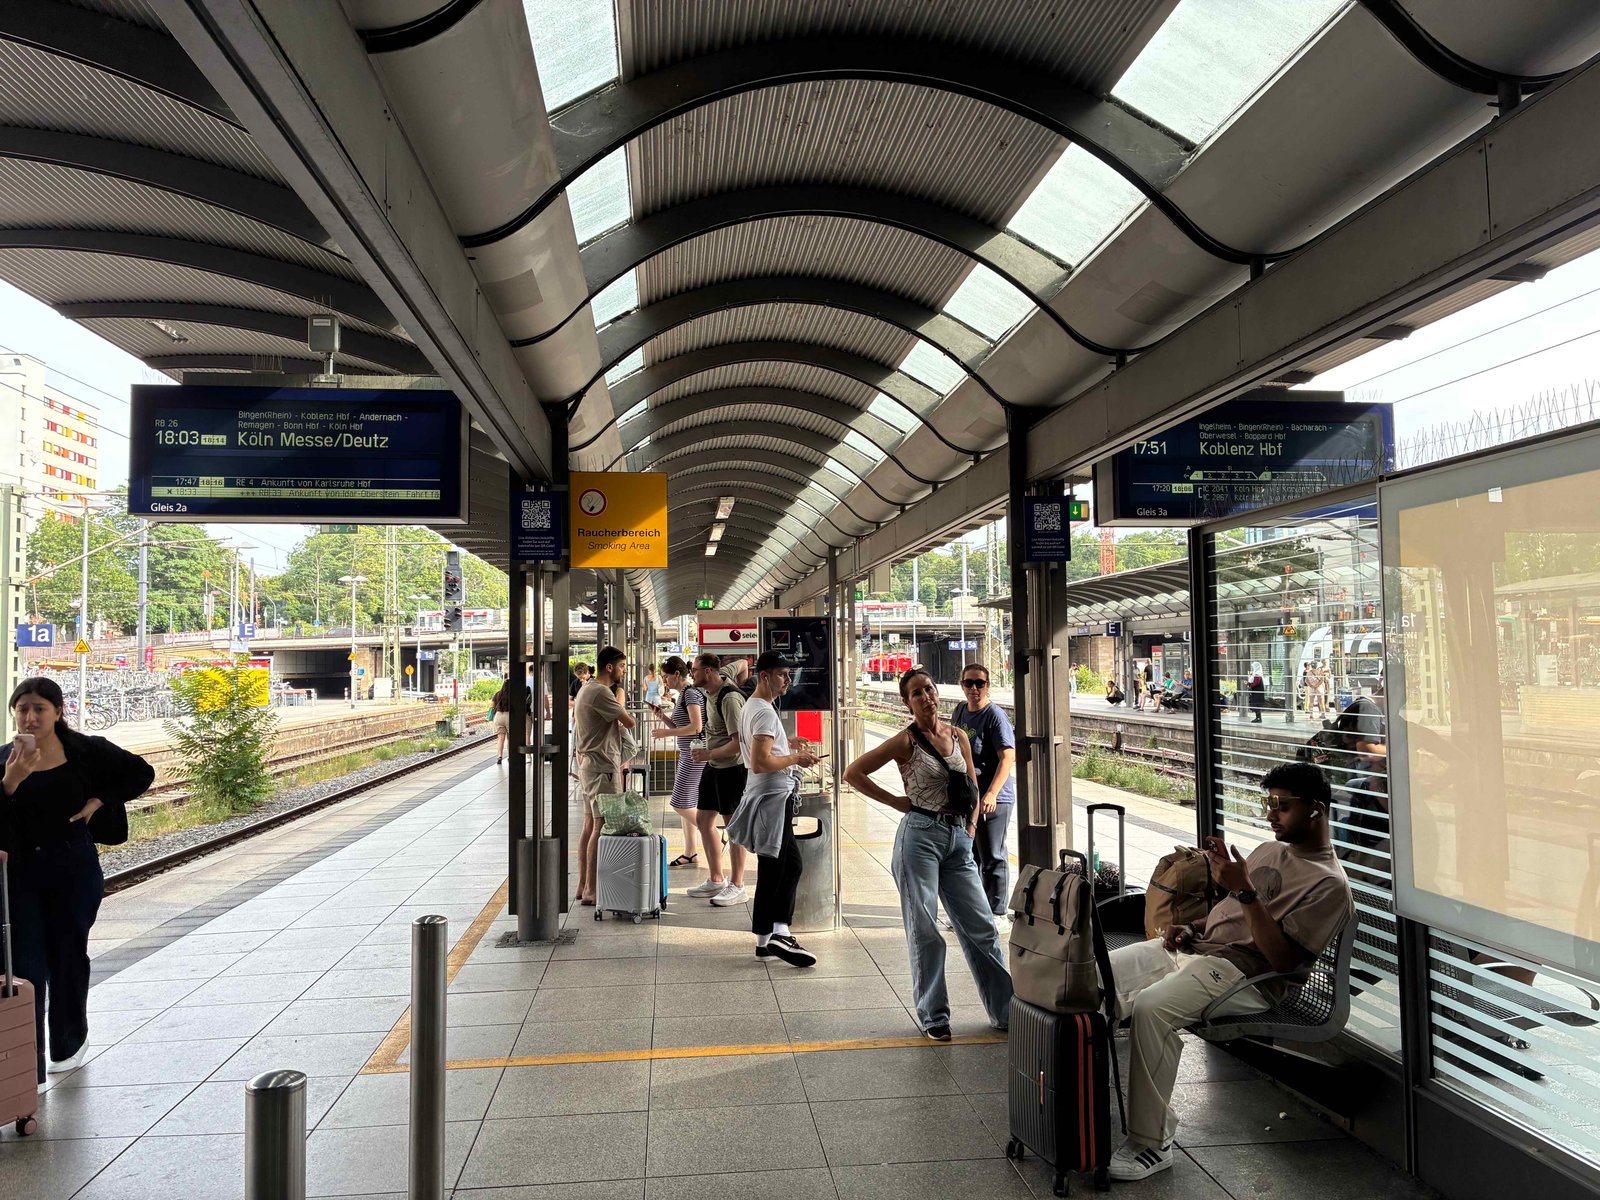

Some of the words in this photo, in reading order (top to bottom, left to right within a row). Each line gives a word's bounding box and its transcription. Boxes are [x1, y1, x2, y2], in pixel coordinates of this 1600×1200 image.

[238, 411, 292, 421] Bingen(Rhein)
[300, 412, 334, 420] Koblenz
[336, 412, 350, 420] Hbf
[359, 413, 402, 421] Andernach
[155, 419, 166, 427] RB
[168, 420, 178, 428] 26
[238, 421, 274, 430] Remagen
[1199, 424, 1232, 432] Ingelheim
[1238, 424, 1284, 432] Bingen(Rhein)
[155, 430, 200, 445] 18:03
[238, 432, 274, 446] Köln
[280, 432, 388, 448] Messe/Deutz
[1134, 441, 1167, 454] 17:51
[1200, 442, 1254, 456] Koblenz
[1260, 442, 1282, 456] Hbf
[261, 479, 294, 487] Ankunft
[150, 502, 174, 512] Gleis
[176, 502, 187, 512] 2a
[1136, 508, 1156, 516] Gleis
[1158, 508, 1168, 516] 3a
[578, 528, 660, 537] Raucherbereich
[588, 542, 626, 551] Smoking
[28, 624, 50, 642] 1a
[244, 624, 253, 636] E
[1109, 623, 1115, 634] E
